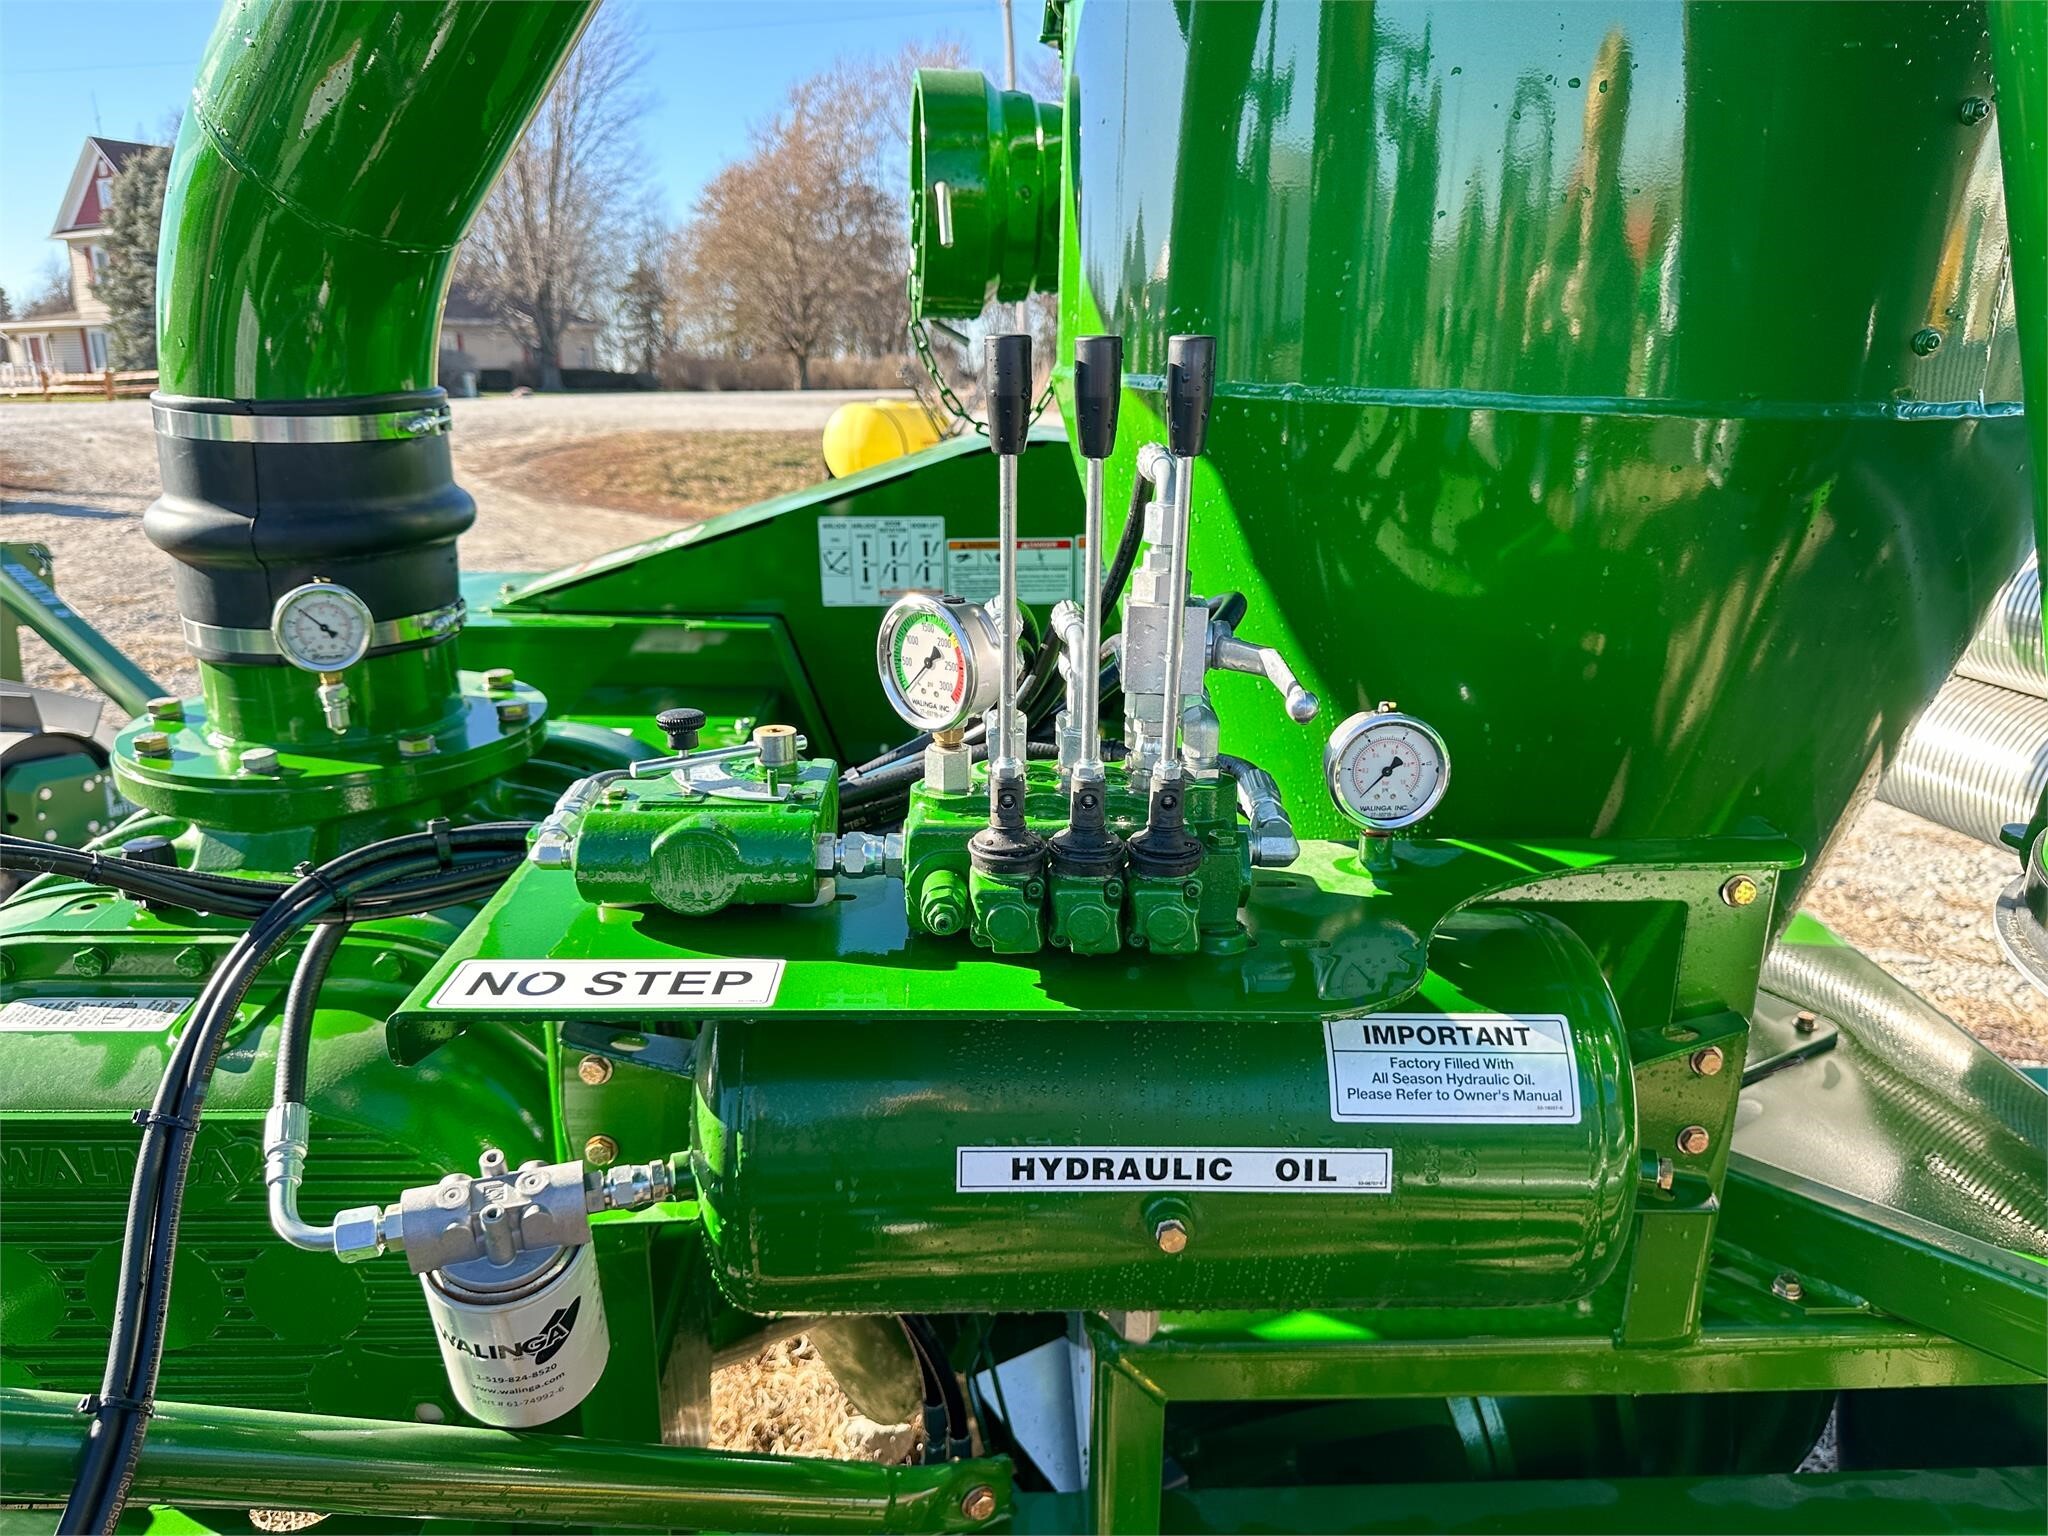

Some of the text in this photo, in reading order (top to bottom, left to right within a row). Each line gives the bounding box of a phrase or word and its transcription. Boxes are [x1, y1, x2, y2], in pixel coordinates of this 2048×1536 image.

[922, 622, 934, 632] 1500
[937, 637, 952, 648] 2000
[944, 660, 958, 672] 2500
[939, 681, 953, 692] 3000
[912, 698, 937, 710] WALINGA
[465, 971, 753, 996] NO STEP
[1363, 1024, 1530, 1046] IMPORTANT
[203, 1043, 220, 1078] Flame
[1390, 1057, 1514, 1070] Factory Filled With
[1372, 1073, 1535, 1086] All Season Hydraulic Oil.
[1347, 1088, 1562, 1101] Please Refer to Owner's Manual
[1012, 1158, 1337, 1182] HYDRAULIC OIL
[437, 1321, 570, 1360] WALINGA
[476, 1363, 558, 1383] 1-519-824-8520
[472, 1371, 565, 1395] www.walinga.com
[506, 1386, 565, 1407] 61-74992-6
